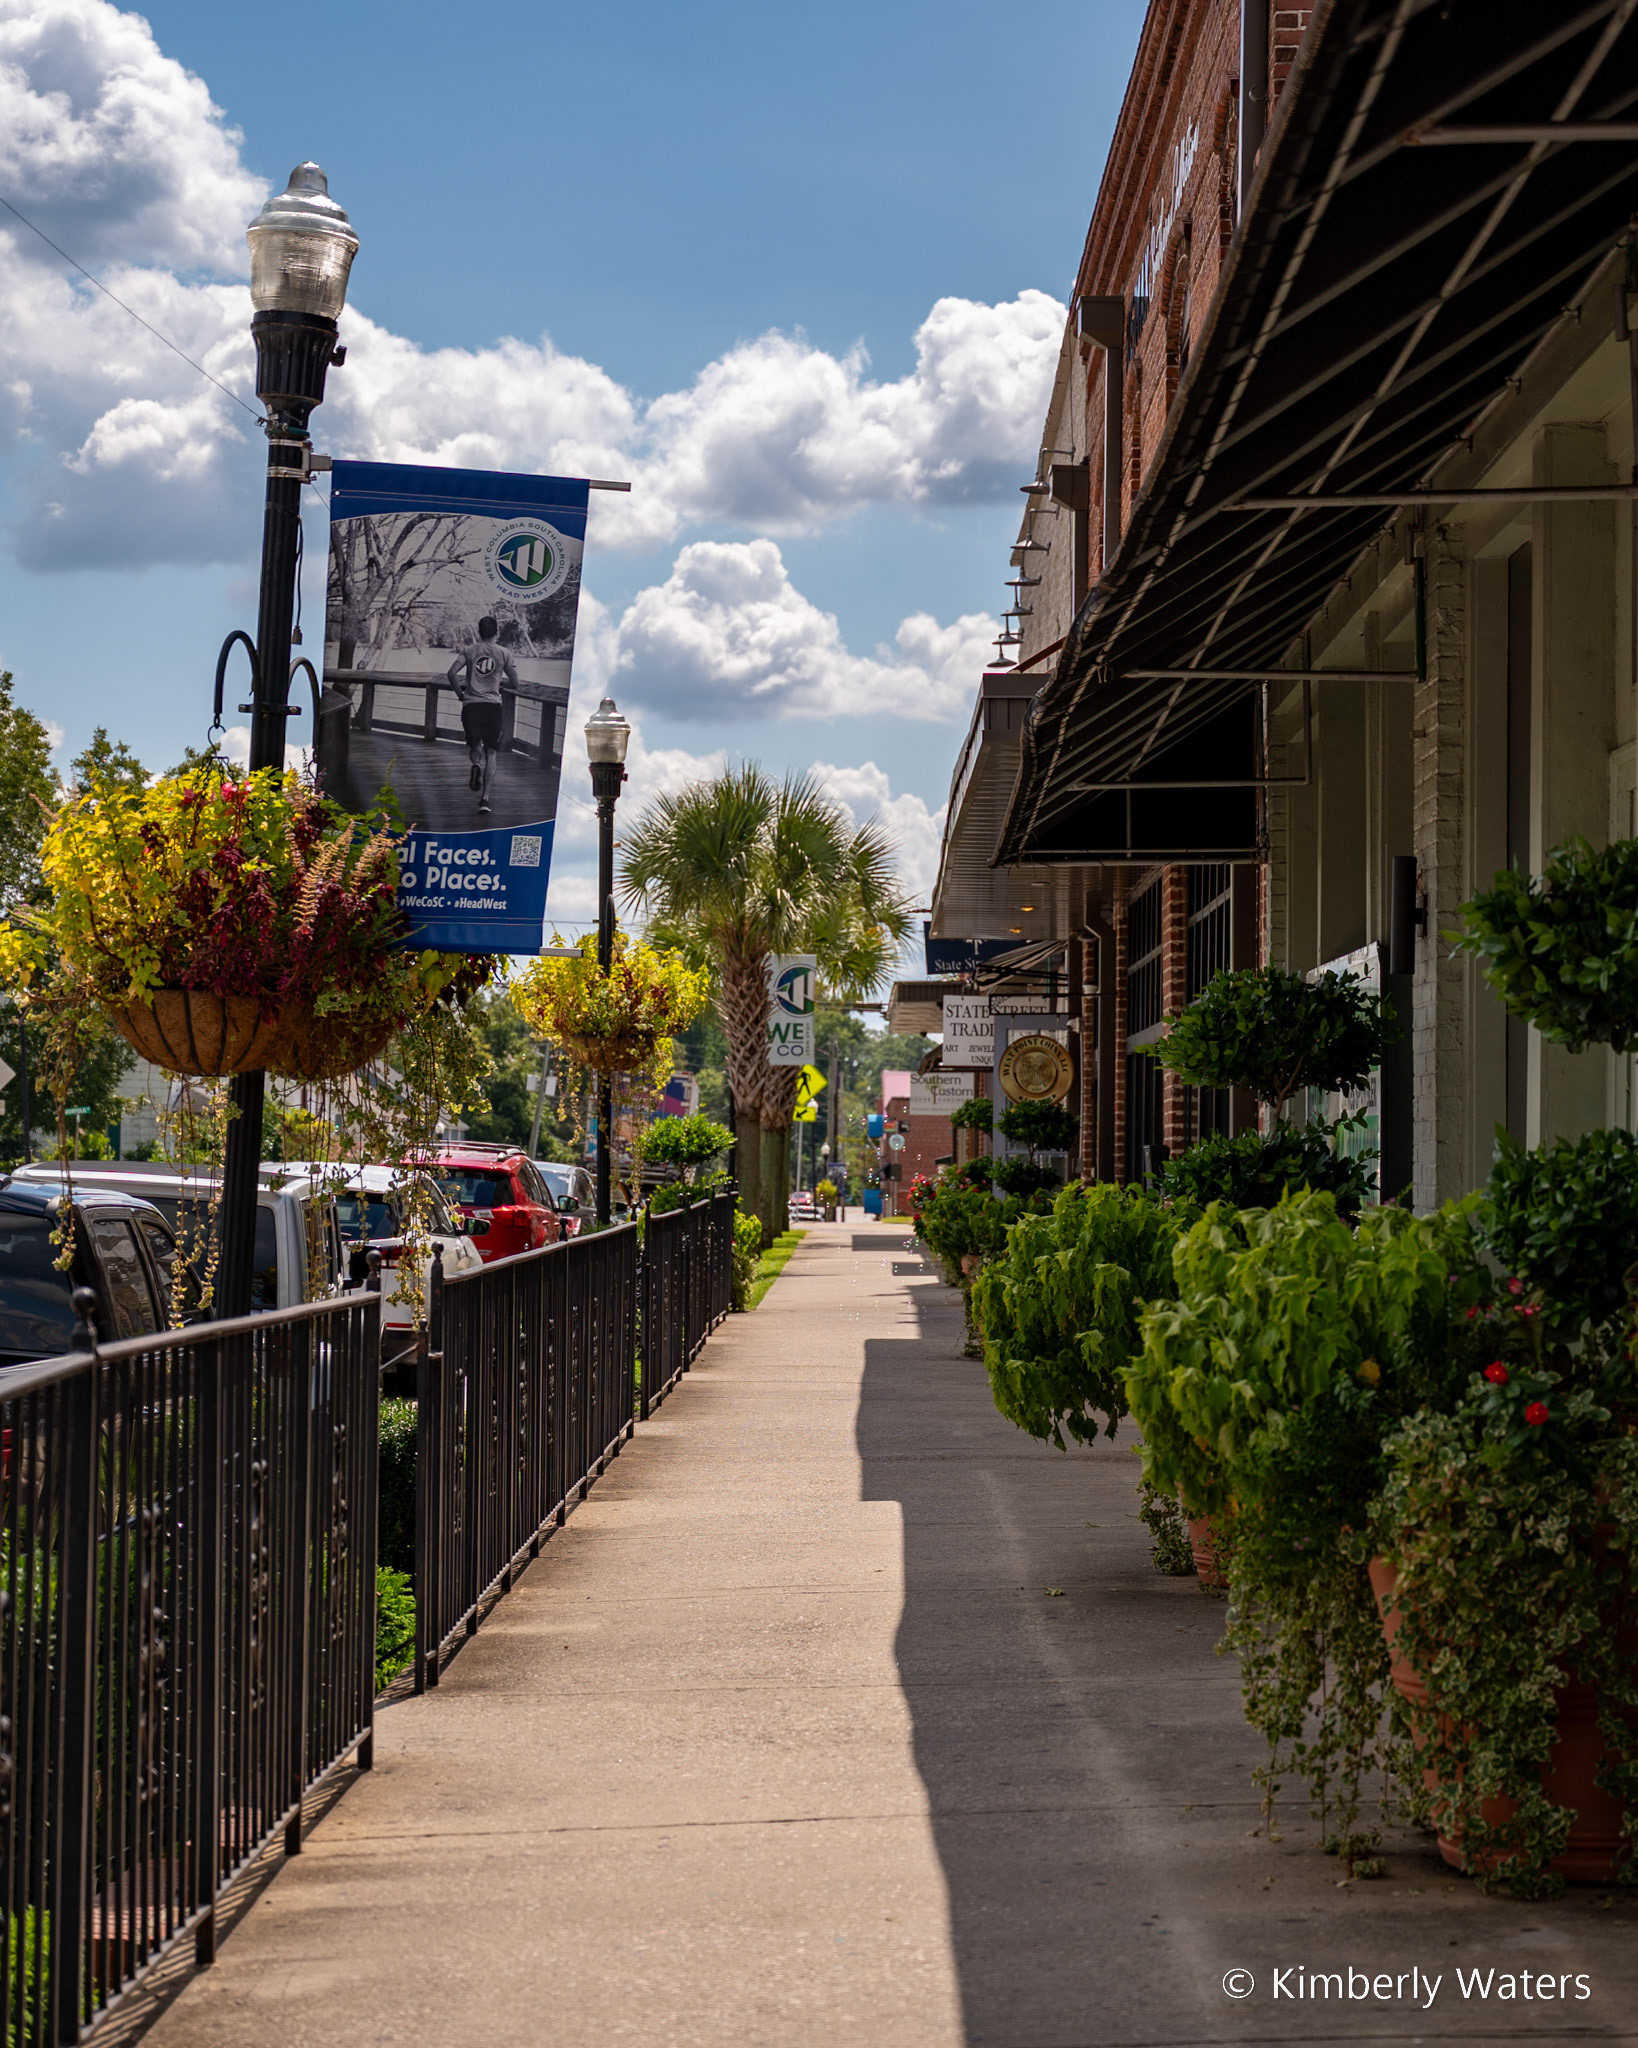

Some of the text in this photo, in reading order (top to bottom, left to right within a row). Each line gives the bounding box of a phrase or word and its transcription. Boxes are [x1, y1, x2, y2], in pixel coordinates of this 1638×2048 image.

[485, 522, 565, 585] WEST COLUMBIA SOUTH CAROLINA
[496, 584, 548, 599] HEAD WEST
[396, 841, 496, 866] al Faces.
[425, 866, 507, 891] Places.
[400, 896, 508, 910] #WeCoSC #HeadWest
[934, 959, 962, 972] State
[946, 1004, 990, 1019] STATE
[766, 1022, 804, 1044] WE
[950, 1022, 994, 1037] TRADI
[777, 1045, 804, 1057] CO
[944, 1044, 959, 1053] ART
[971, 1055, 994, 1065] UNIQU
[1003, 1052, 1015, 1076] WEST
[1014, 1039, 1038, 1053] POINT
[911, 1073, 961, 1085] Southern
[931, 1085, 973, 1097] Custom
